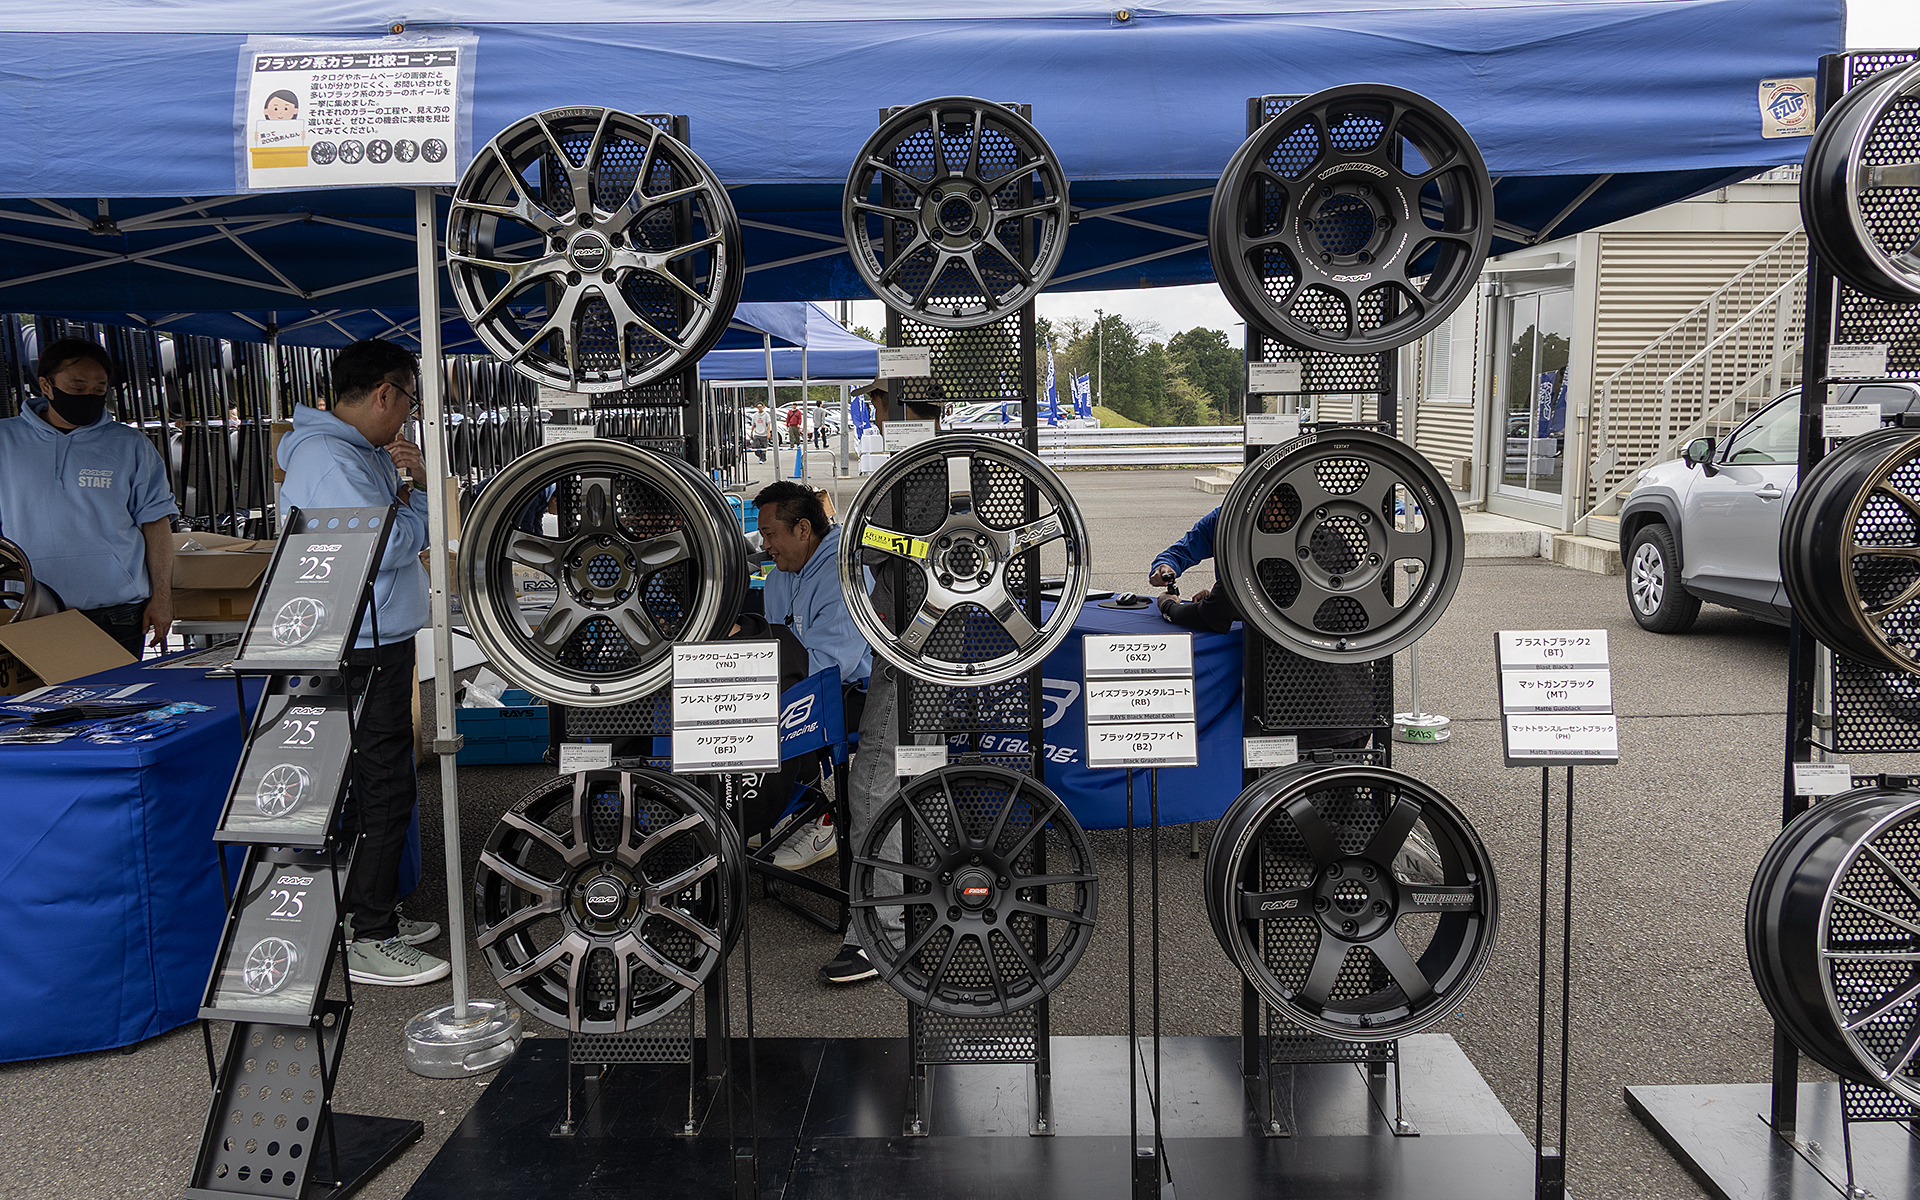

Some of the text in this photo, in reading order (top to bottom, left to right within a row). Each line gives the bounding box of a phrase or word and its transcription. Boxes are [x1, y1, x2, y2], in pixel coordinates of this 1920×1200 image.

[258, 55, 452, 70] ブラック系カラー比較コーナー
[311, 71, 443, 82] カタログやホームページの画像だと
[551, 109, 594, 119] HOMURA
[308, 126, 379, 135] べてみてください。
[574, 248, 604, 256] RAYS
[584, 384, 616, 392] RAYS
[78, 476, 112, 488] STAFF
[1015, 520, 1057, 546] RAYS
[306, 544, 342, 552] RAYS
[523, 580, 557, 591] RAY
[1515, 638, 1591, 646] ブラストブラック2
[1109, 643, 1167, 652] グラスブラック
[678, 651, 774, 661] ブラッククロームコーティング
[1126, 654, 1152, 662] (6XZ)
[1543, 649, 1564, 658] (BT)
[1519, 680, 1594, 688] マットガンブラック
[1091, 688, 1191, 698] レイズブラックメタルコート
[1546, 691, 1568, 699] (MT)
[1131, 699, 1150, 707] (RB)
[290, 707, 326, 715] RAYS
[714, 704, 737, 713] (PW)
[785, 720, 819, 742] racing.
[1408, 730, 1432, 739] RAYS
[697, 735, 754, 745] クリアブラック
[1100, 732, 1184, 742] ブラックグラファイト
[714, 745, 737, 754] (BFJ)
[998, 736, 1078, 763] racng.
[1132, 743, 1152, 752] (B2)
[277, 876, 314, 886] RAYS
[1260, 898, 1298, 911] RAYS
